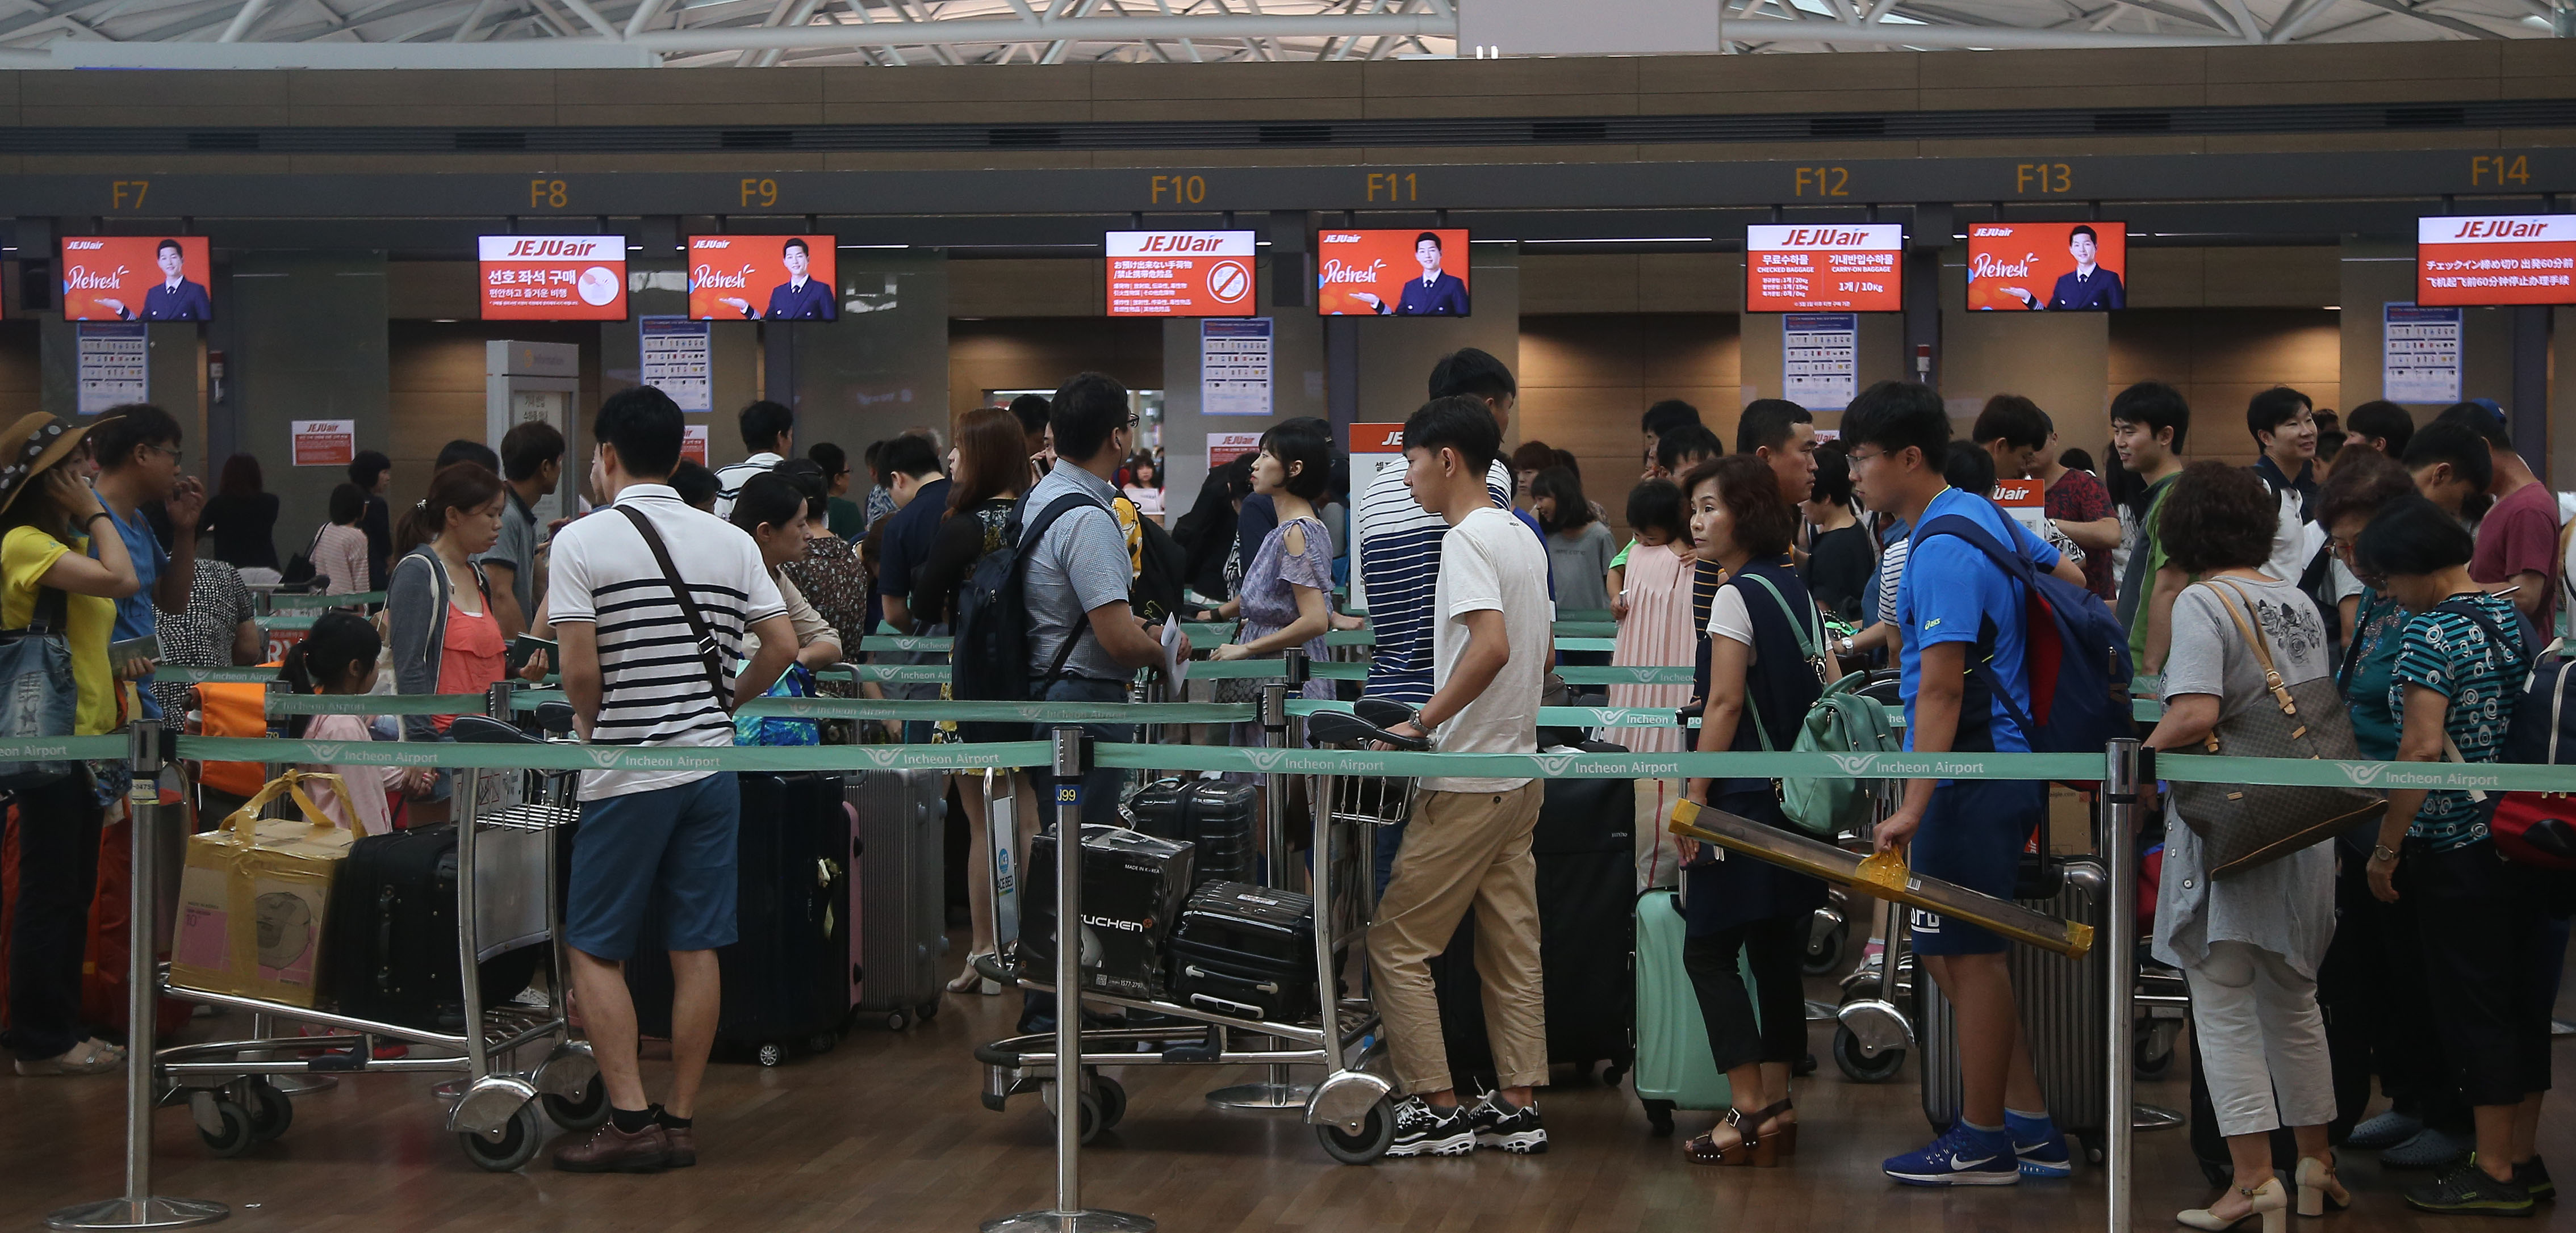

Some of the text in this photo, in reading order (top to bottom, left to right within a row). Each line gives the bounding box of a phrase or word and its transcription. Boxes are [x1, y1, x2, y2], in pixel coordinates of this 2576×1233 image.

[2472, 156, 2528, 185] F14
[1796, 168, 1849, 196] F12
[2018, 165, 2071, 193] F13
[113, 181, 148, 208] F7
[531, 180, 567, 208] F8
[741, 179, 777, 207] F9
[1152, 176, 1206, 204] F10
[1367, 173, 1417, 201] F11
[1974, 228, 2013, 237] JEJUair
[2454, 219, 2548, 238] JEJUair
[693, 240, 730, 249] JEJUair
[1139, 234, 1223, 251] JEJUair
[1323, 234, 1361, 243] JEJUair
[1782, 228, 1869, 246] JEJUair
[67, 241, 104, 250] JEJUair
[508, 240, 596, 257] JEJUair
[1762, 254, 1809, 265] 무료수하물
[1829, 254, 1893, 265] 기내반입수하물
[1974, 252, 2029, 278] Refresh
[68, 265, 120, 290] Refresh
[488, 270, 576, 285] 선호 좌석 구매
[694, 264, 746, 290] Refresh
[1324, 258, 1377, 283] Refresh
[488, 288, 568, 298] 편안하고 즐거운 비행
[1838, 282, 1854, 292] 1개
[307, 423, 339, 432] JEJUair
[1222, 435, 1254, 444] JEJUair
[1381, 431, 1404, 446] JE
[1992, 486, 2029, 501] Uair
[213, 672, 278, 682] Incheon Airpor
[901, 671, 952, 680] Incheon Air
[1626, 714, 1668, 724] Incheon
[24, 744, 68, 758] Airport
[344, 750, 438, 765] Incheon Airport
[625, 754, 721, 769] Incheon Airport
[904, 752, 1000, 766] Incheon Airport
[1285, 758, 1385, 773] Incheon Airport
[1575, 761, 1679, 775] Incheon Airport
[1876, 761, 1984, 776] Incheon Airport
[2386, 771, 2498, 787] Incheon Airport
[1057, 789, 1076, 802] J99
[1081, 914, 1144, 933] UCHEN
